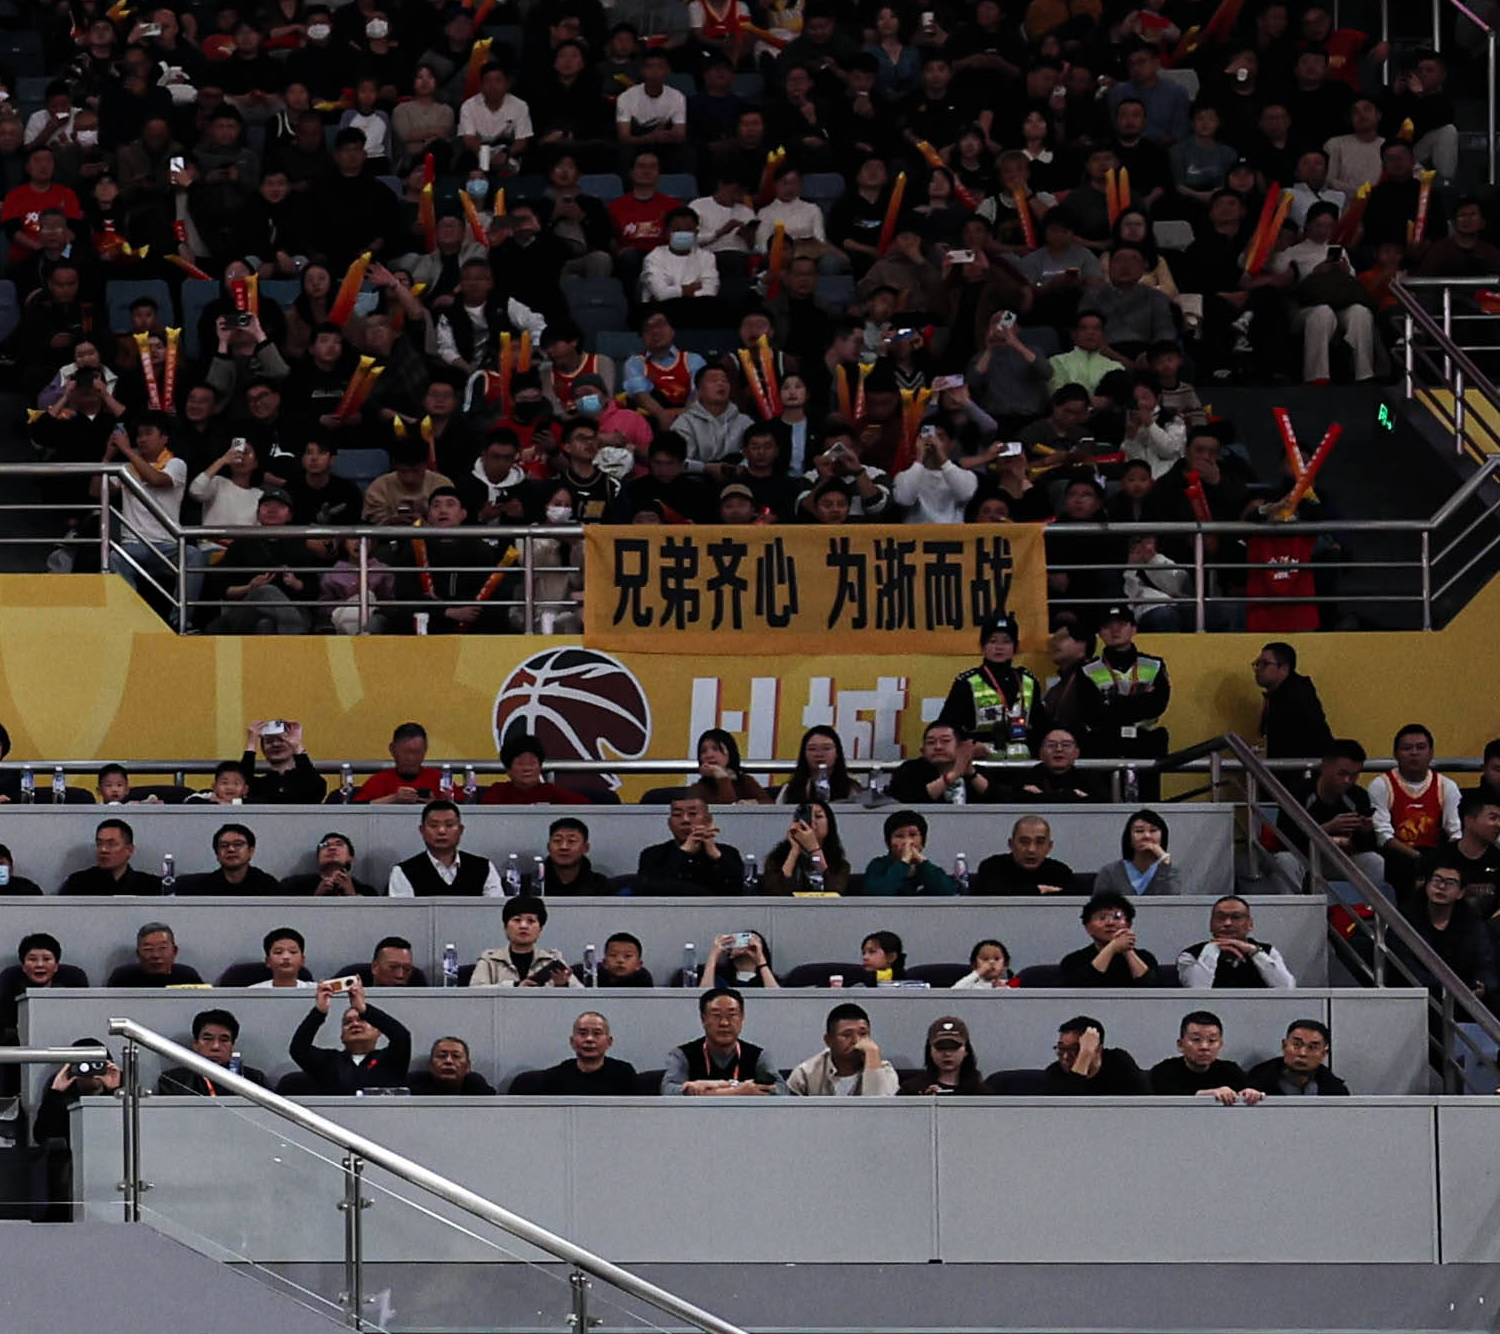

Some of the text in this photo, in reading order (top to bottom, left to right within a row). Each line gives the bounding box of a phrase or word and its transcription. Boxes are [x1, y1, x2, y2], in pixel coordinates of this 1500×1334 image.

[613, 537, 1013, 630] 兄弟齐心 为浙而战
